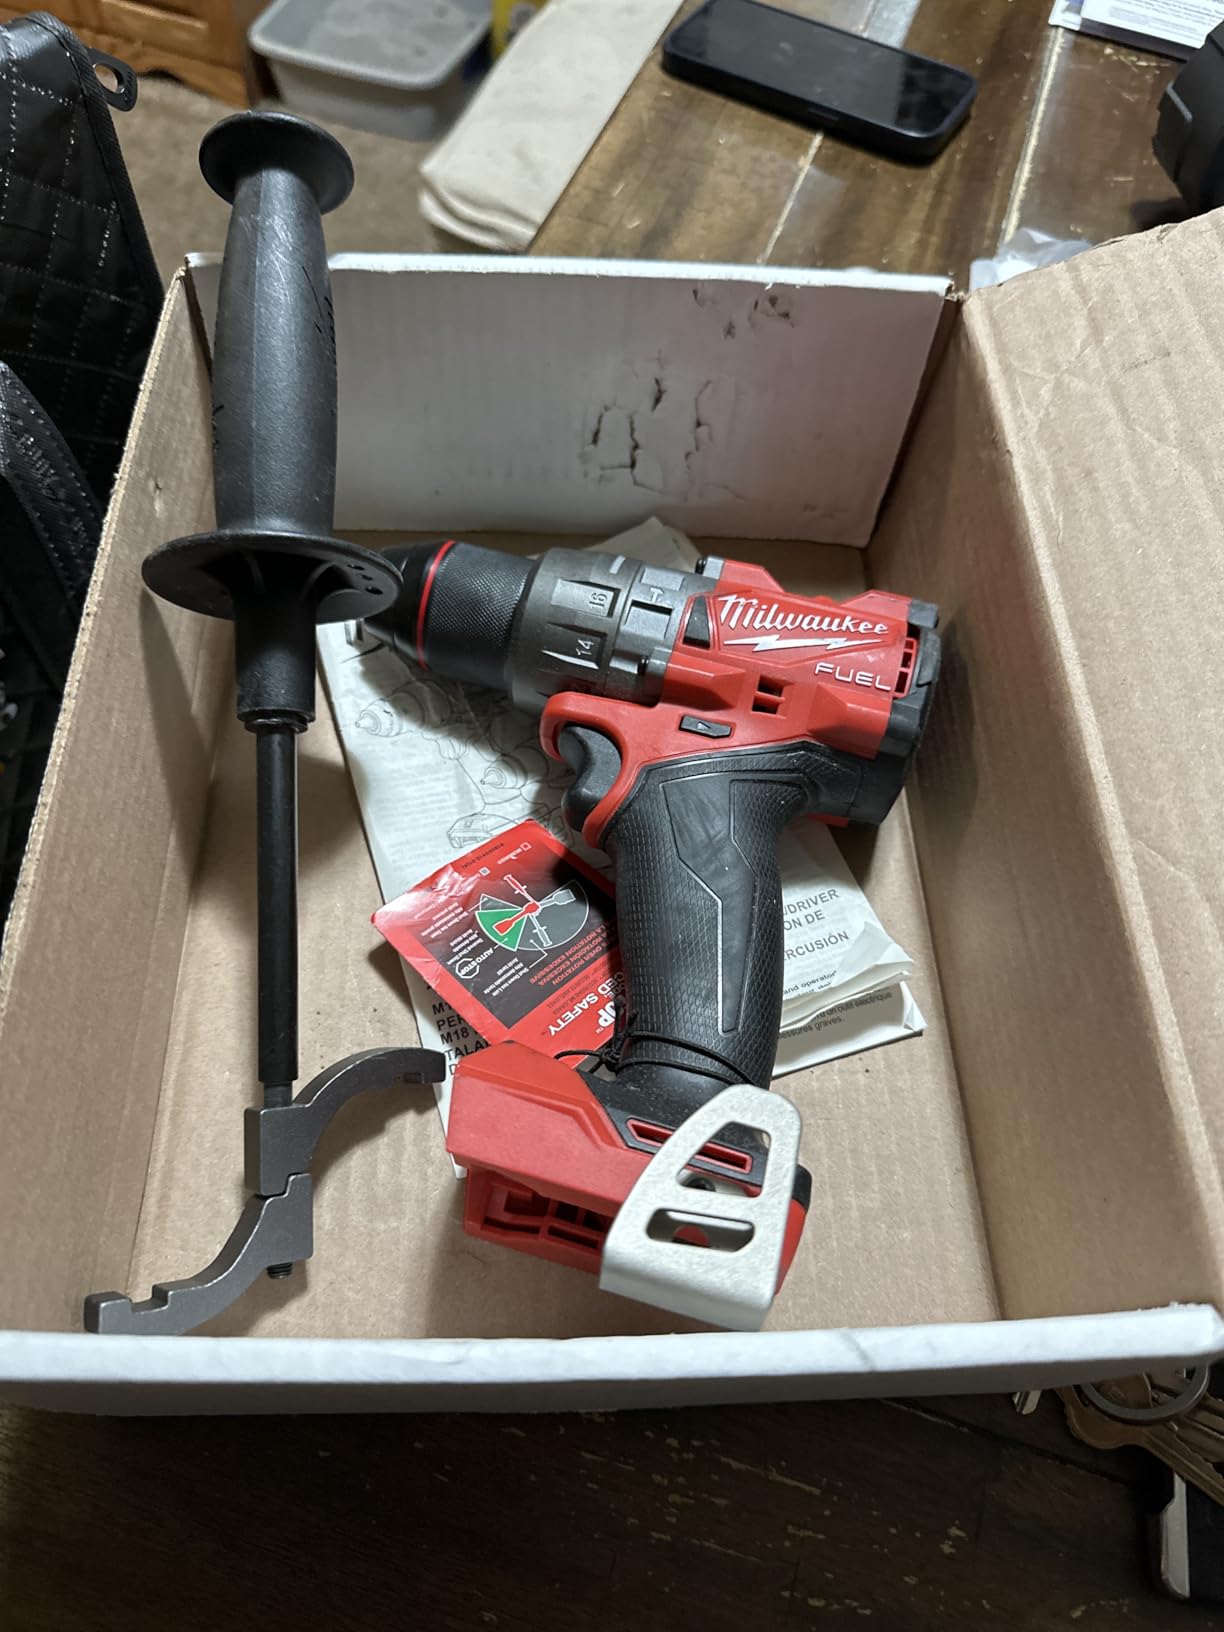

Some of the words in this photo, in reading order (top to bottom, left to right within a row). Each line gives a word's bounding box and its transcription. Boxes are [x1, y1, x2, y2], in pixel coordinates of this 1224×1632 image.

[718, 594, 889, 635] Milwaukee
[575, 638, 595, 657] 14
[814, 662, 891, 691] FUEL
[784, 889, 839, 915] /DRIVER
[804, 909, 825, 924] DE
[784, 931, 849, 960] RCUSIÓN
[432, 1001, 452, 1015] M1
[548, 993, 599, 1035] SAFETY
[441, 1027, 469, 1044] M18
[781, 1025, 813, 1039] essures
